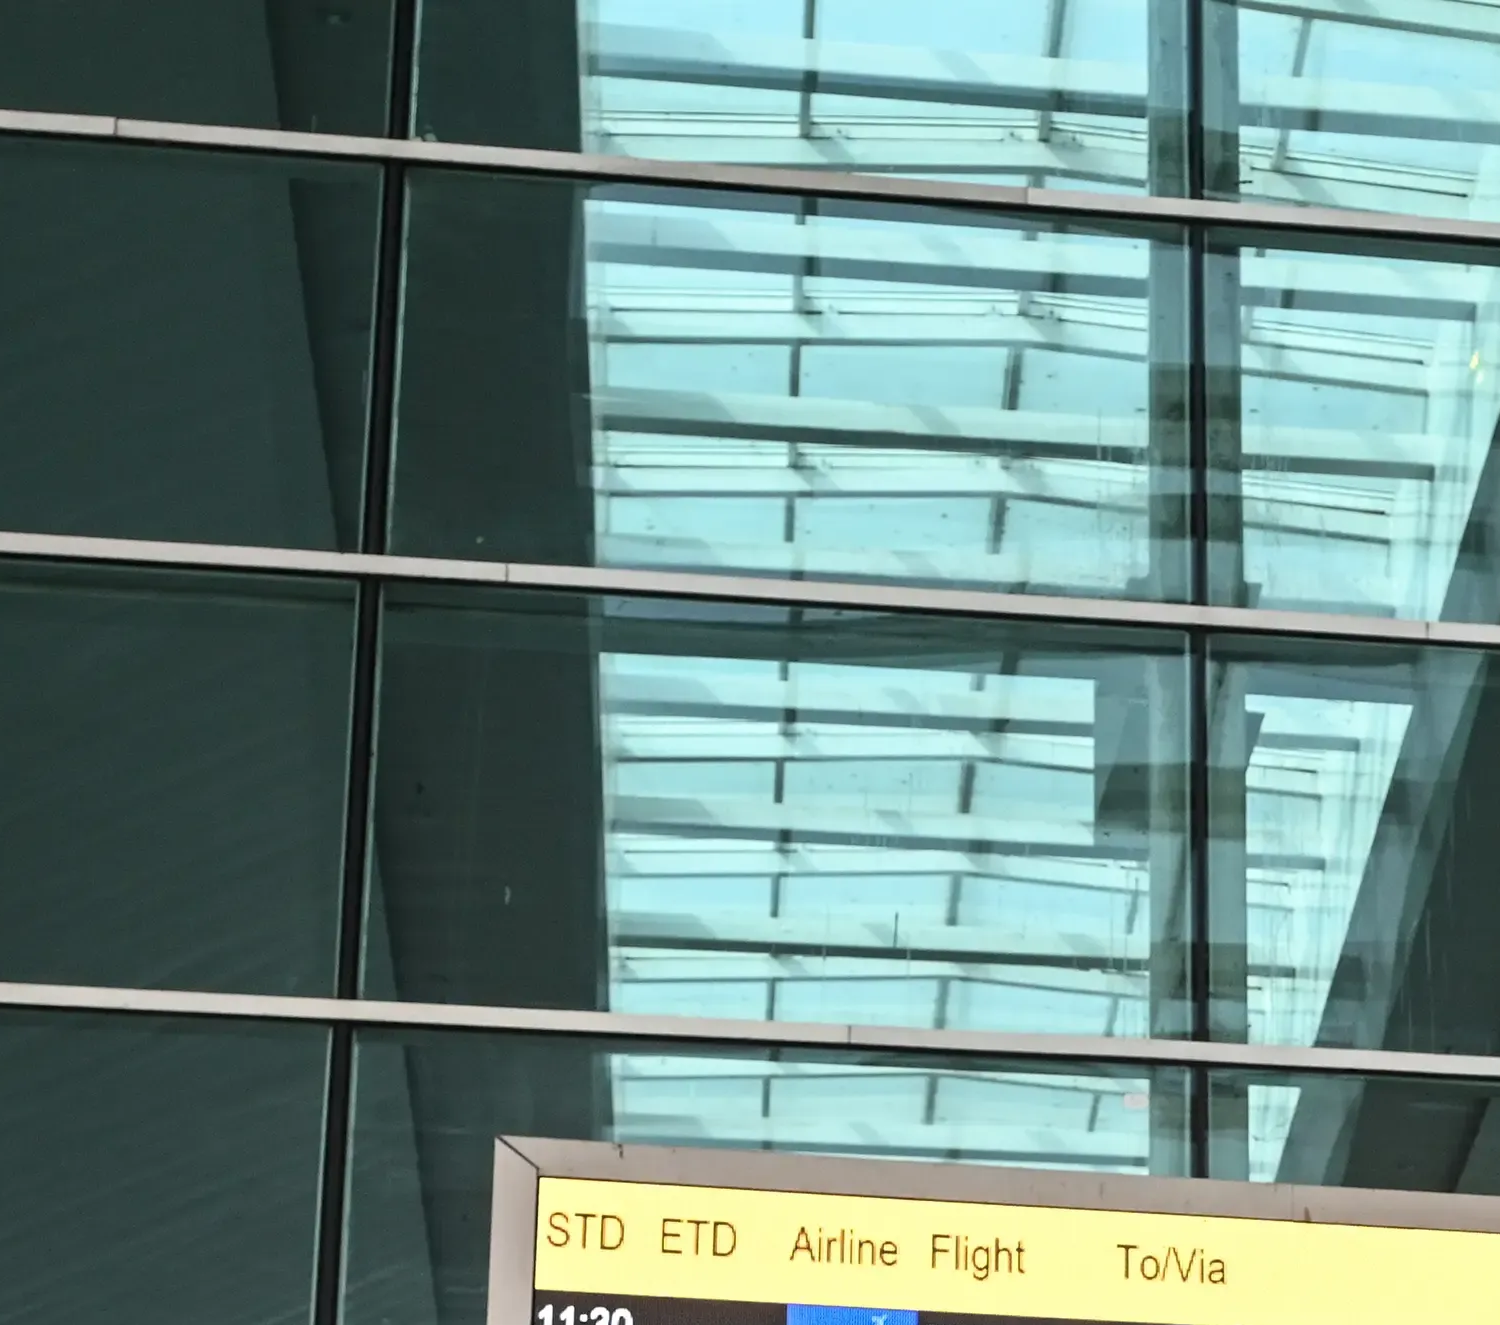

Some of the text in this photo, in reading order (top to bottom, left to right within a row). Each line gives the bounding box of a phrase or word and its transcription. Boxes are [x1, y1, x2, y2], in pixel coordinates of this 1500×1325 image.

[547, 1212, 624, 1250] STD
[662, 1219, 736, 1256] ETD
[790, 1227, 897, 1266] Airline
[932, 1234, 1025, 1280] Flight
[1117, 1244, 1225, 1284] To/Via
